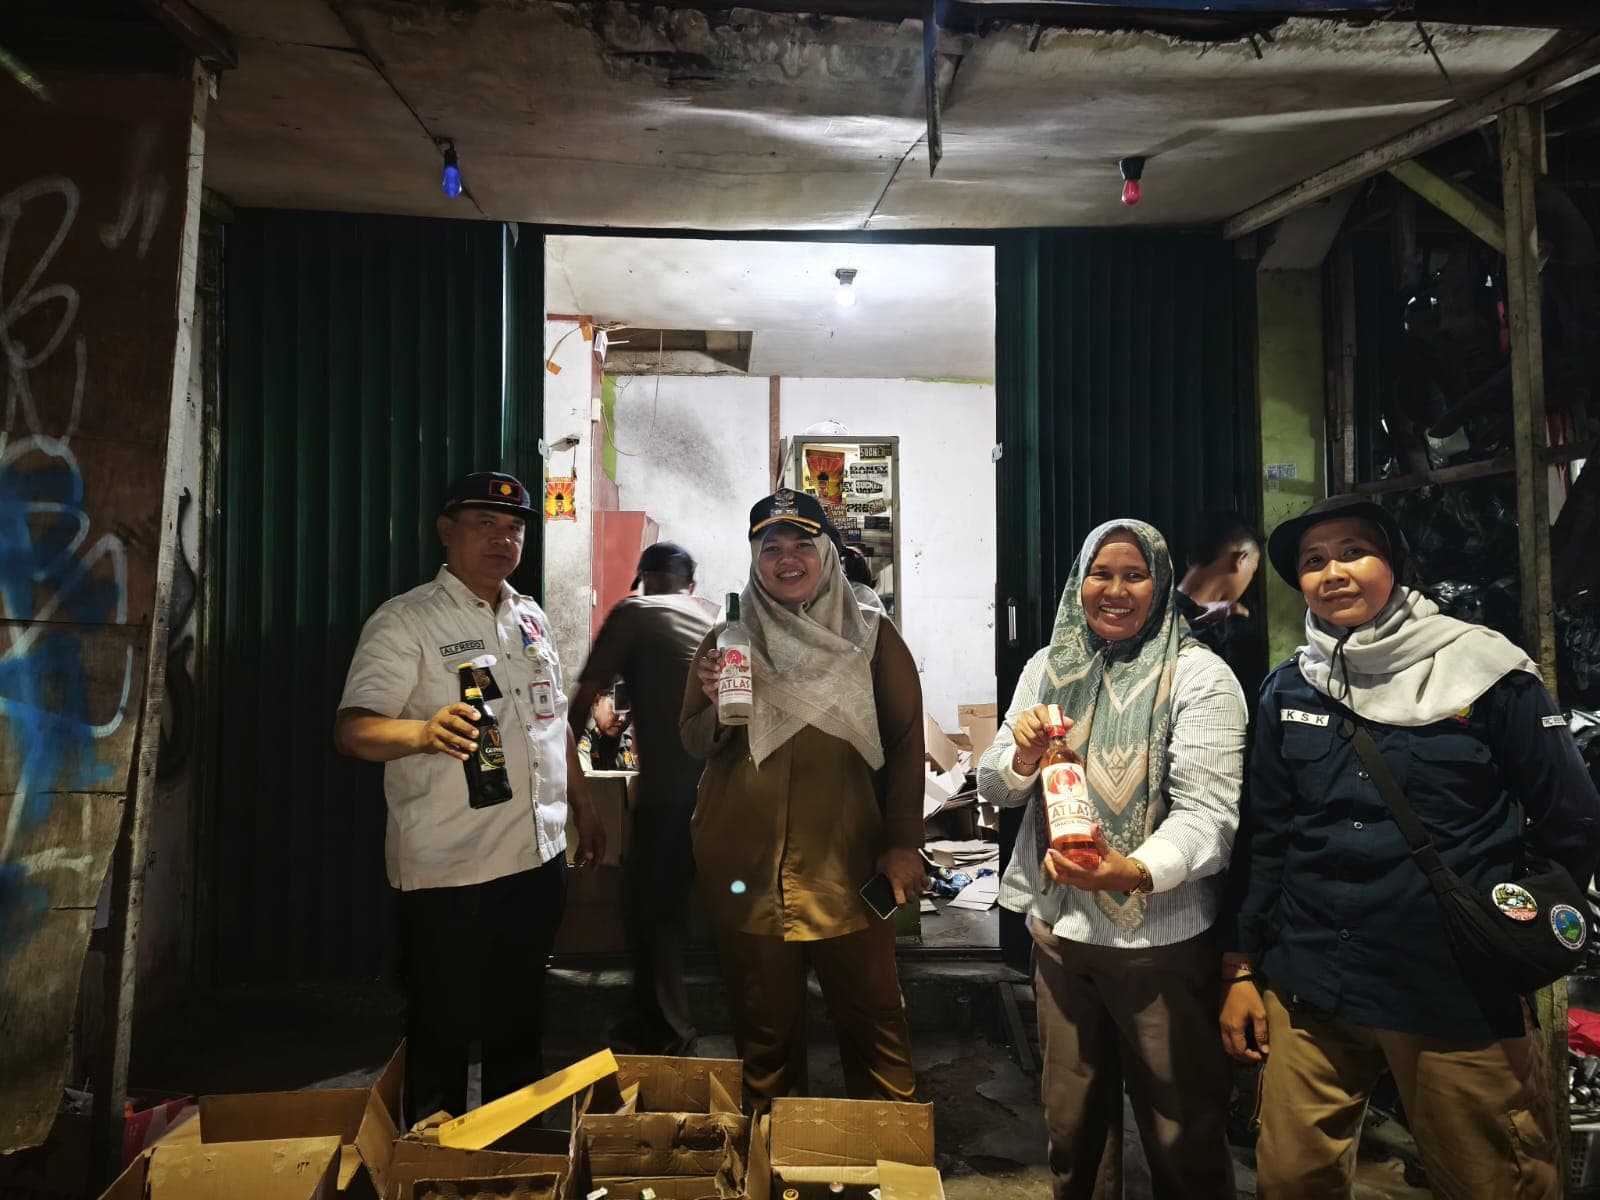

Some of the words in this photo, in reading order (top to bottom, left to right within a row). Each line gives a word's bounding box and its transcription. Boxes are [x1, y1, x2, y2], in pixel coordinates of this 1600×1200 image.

[444, 641, 481, 654] ALFREDO
[721, 679, 751, 690] ATLAS
[1052, 803, 1089, 819] ATLAS
